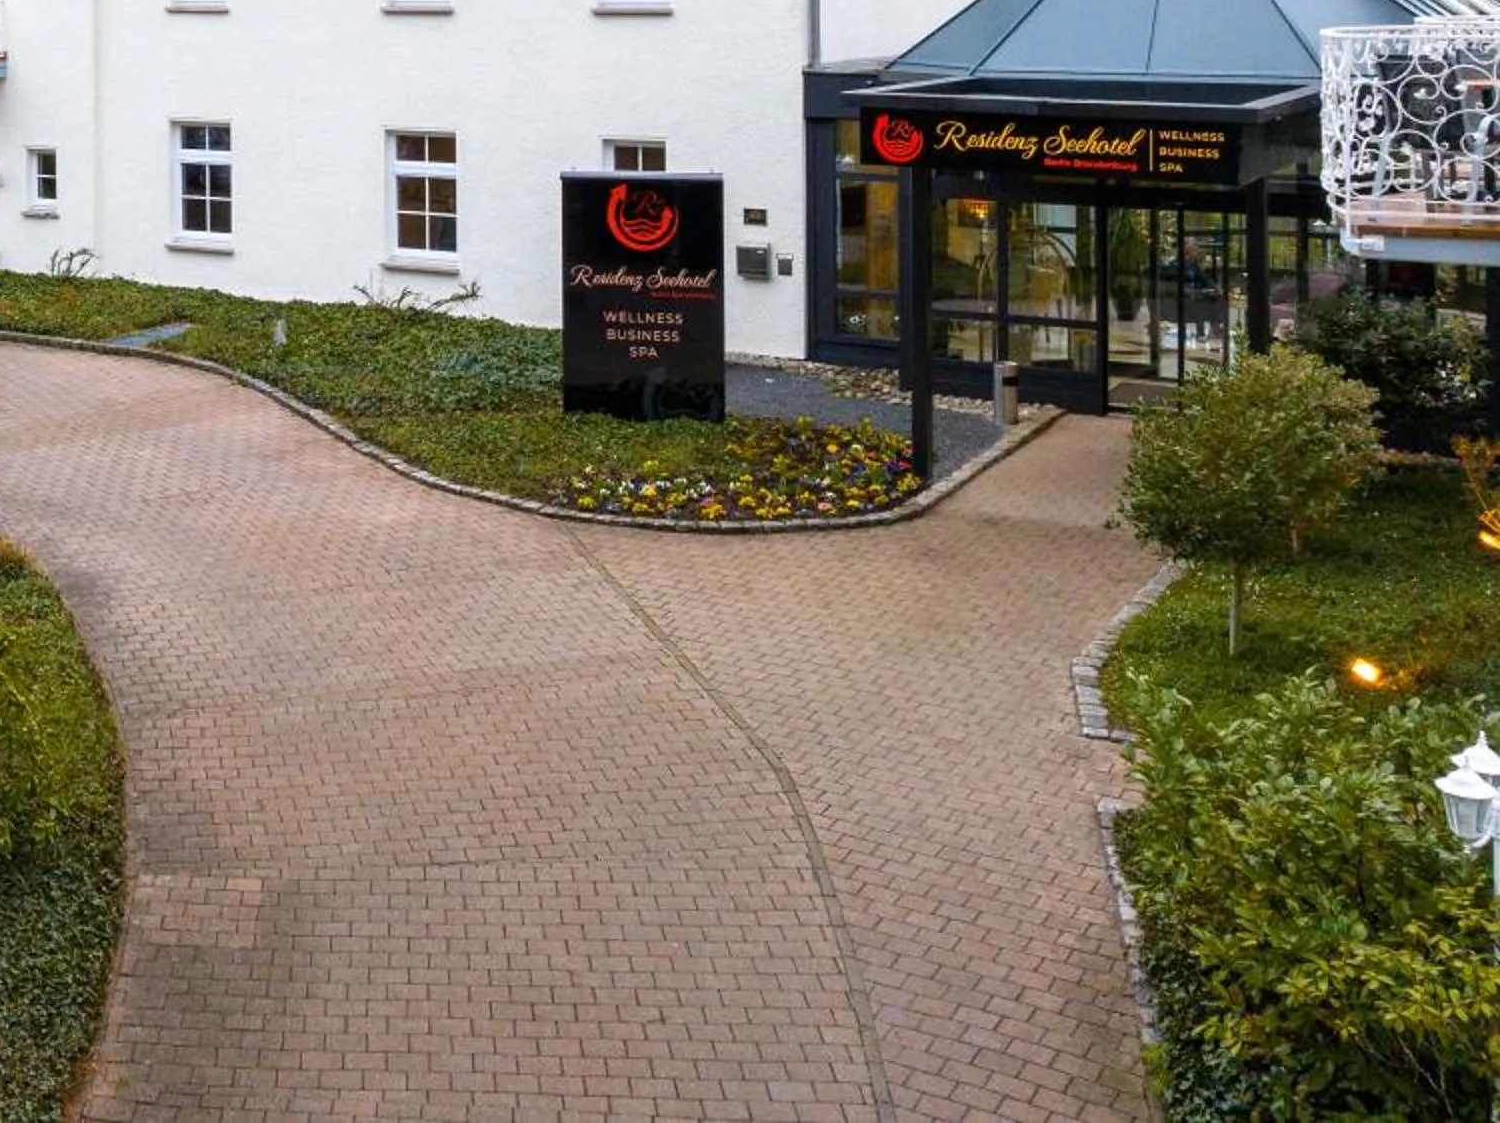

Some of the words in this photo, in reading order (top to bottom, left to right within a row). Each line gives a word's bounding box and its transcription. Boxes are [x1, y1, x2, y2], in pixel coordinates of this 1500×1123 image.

[933, 120, 1038, 159] Residenz
[1043, 125, 1146, 156] Seehotel
[1158, 130, 1225, 142] WELLNESS
[1159, 146, 1220, 159] BUSINESS
[1159, 162, 1183, 172] SPA
[570, 264, 643, 292] Residenz
[647, 266, 717, 288] Seehotel
[603, 310, 684, 326] WELLNESS
[606, 328, 681, 343] BUSINESS
[628, 346, 660, 358] SPA
